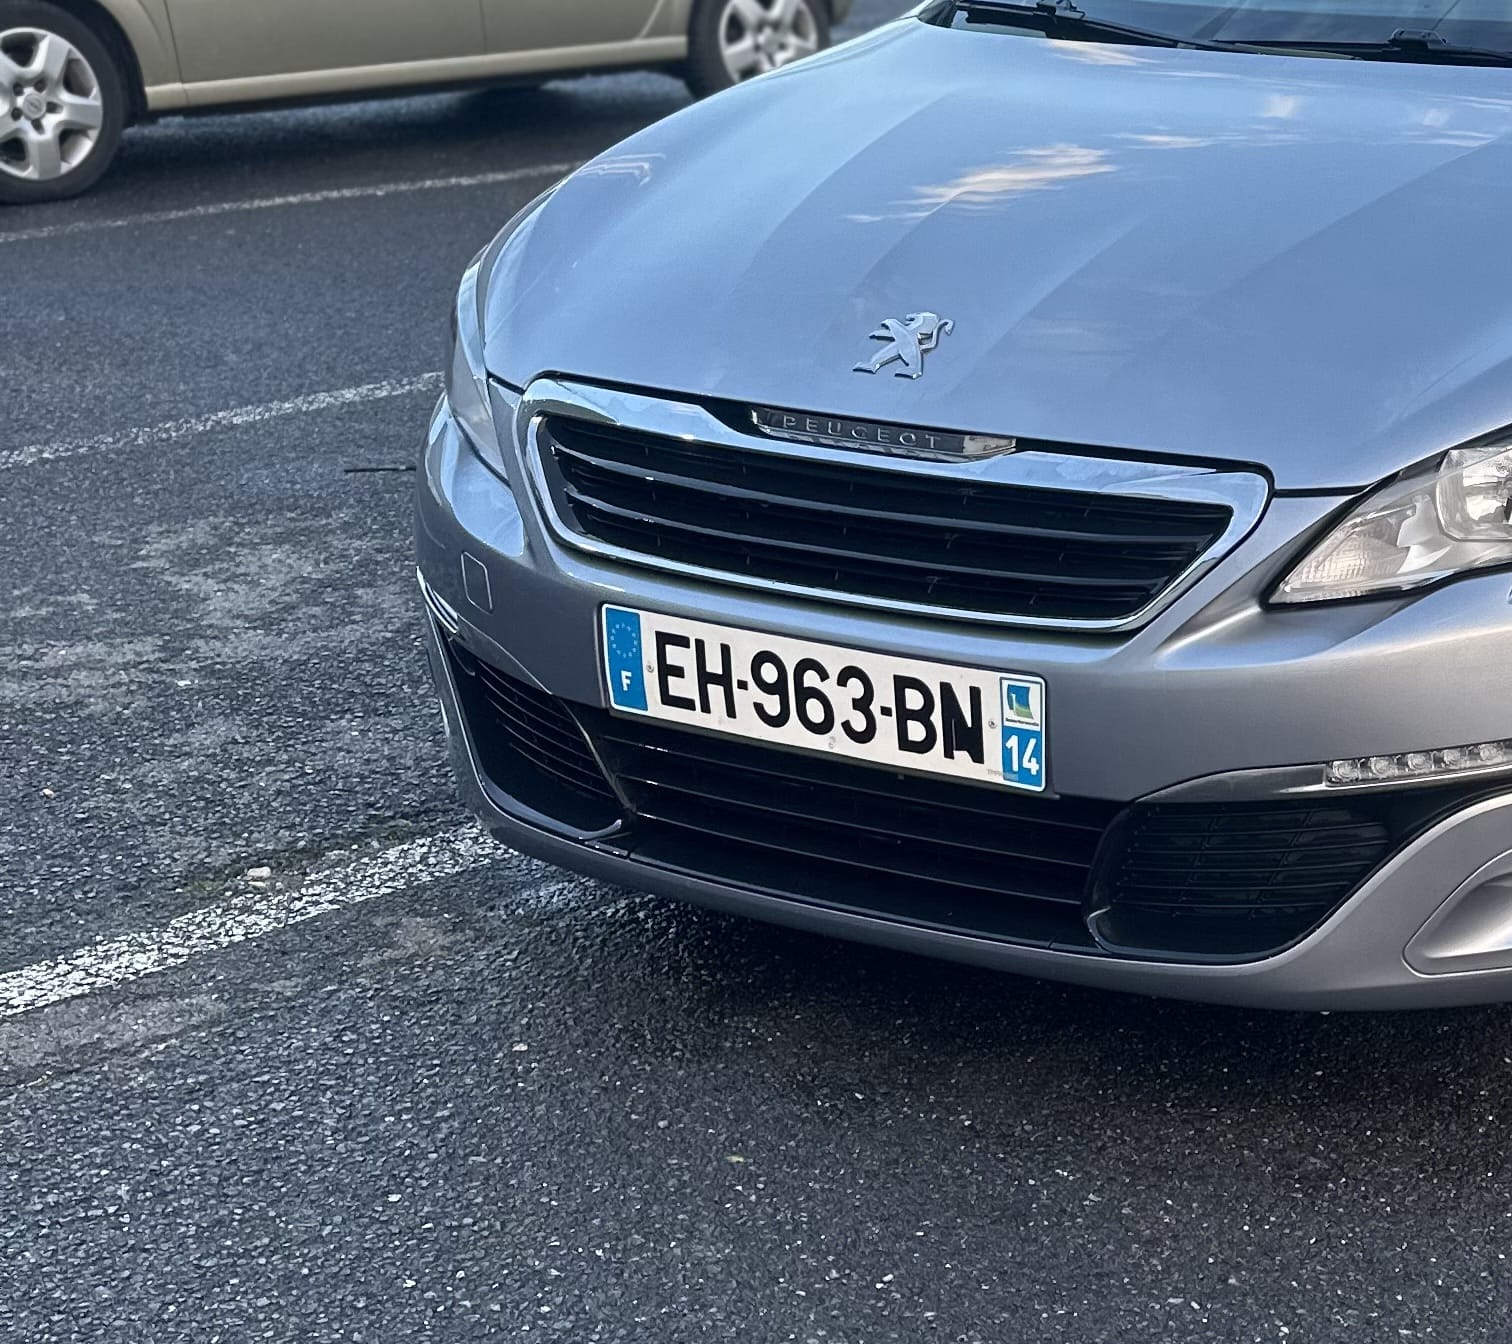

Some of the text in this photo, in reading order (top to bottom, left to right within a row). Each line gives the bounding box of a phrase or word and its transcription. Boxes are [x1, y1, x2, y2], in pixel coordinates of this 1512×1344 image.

[782, 414, 941, 449] PEUGEOT
[620, 669, 633, 692] F
[654, 629, 985, 765] EH-963-BN
[1005, 734, 1040, 776] 14
